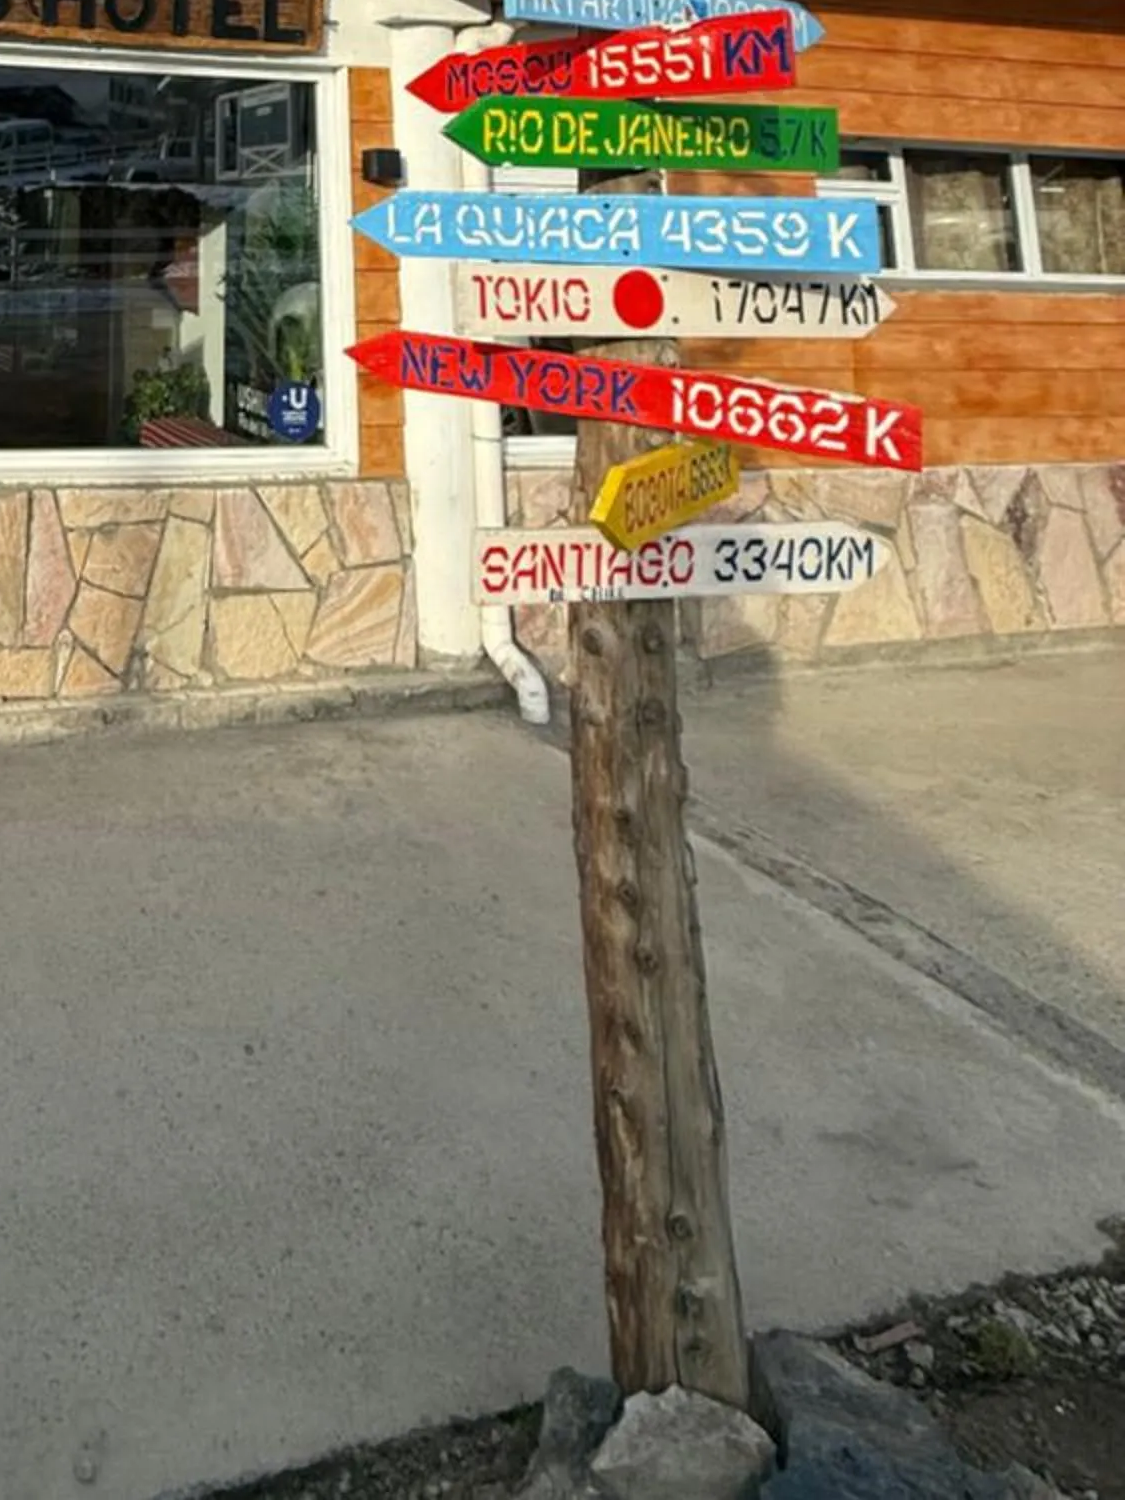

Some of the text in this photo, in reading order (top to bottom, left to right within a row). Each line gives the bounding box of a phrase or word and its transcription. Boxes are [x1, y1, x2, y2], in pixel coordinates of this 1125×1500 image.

[447, 26, 790, 100] MOSCU 15551 KM
[484, 108, 544, 155] RIO
[553, 110, 598, 155] DE
[604, 113, 750, 158] JANEIRO
[387, 203, 862, 260] LA QUIACA 4359 K
[472, 274, 590, 323] TOKIO
[401, 341, 902, 462] NEW YORK 10662 K
[625, 464, 686, 533] BOGOTA
[482, 538, 695, 593] SANTIAGO
